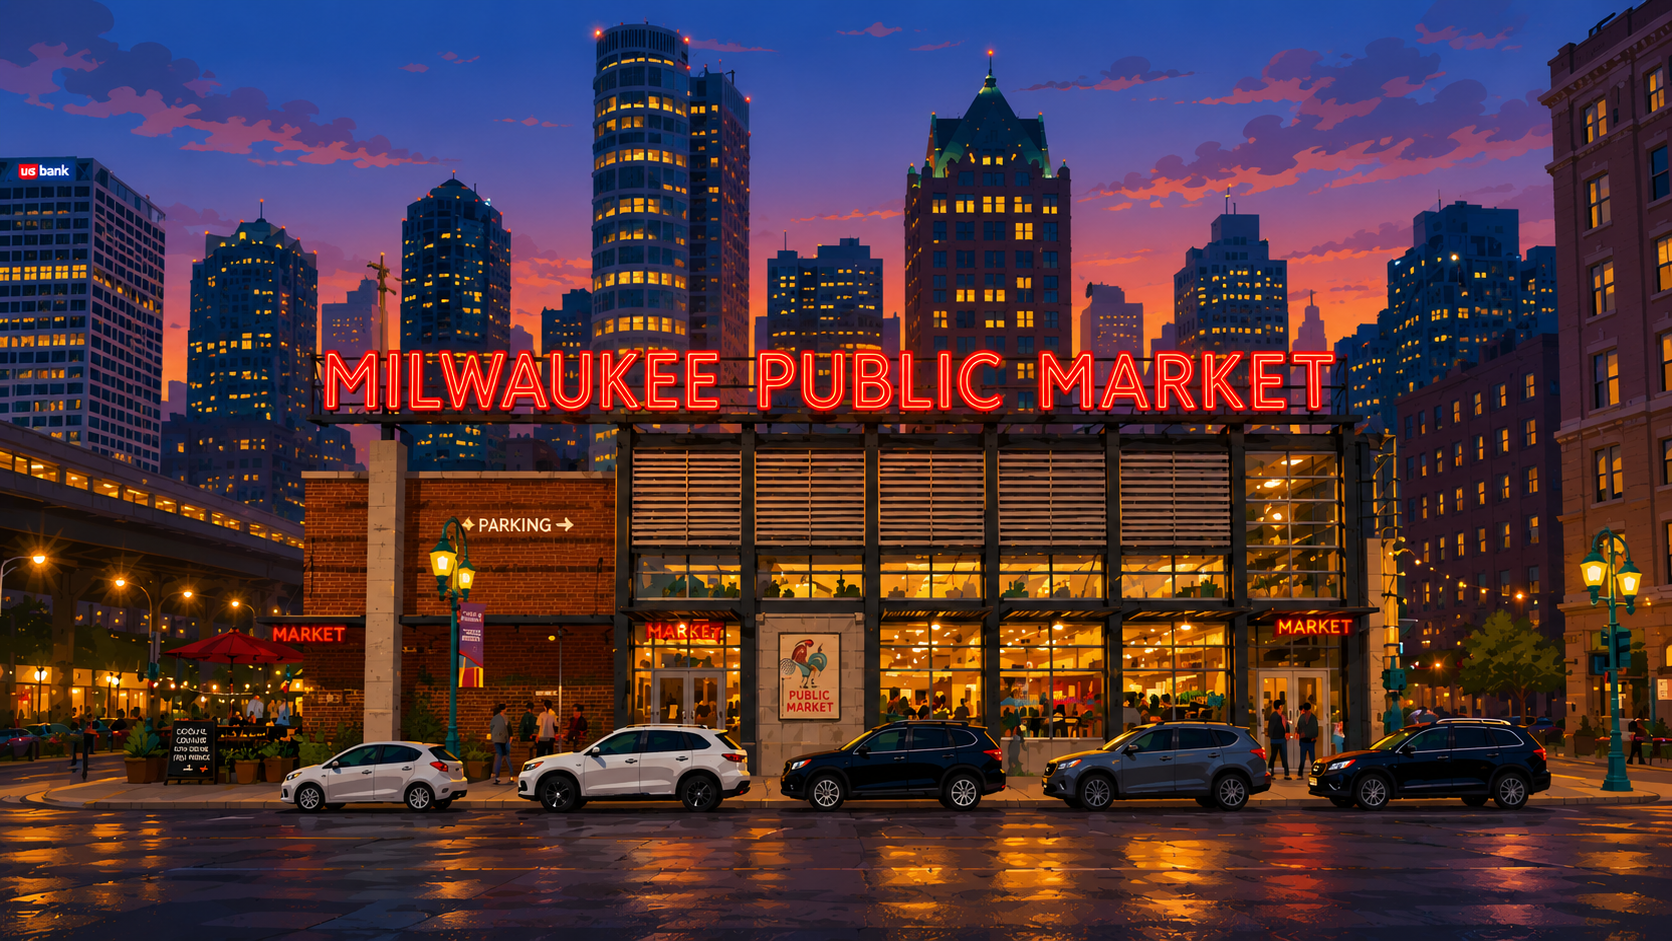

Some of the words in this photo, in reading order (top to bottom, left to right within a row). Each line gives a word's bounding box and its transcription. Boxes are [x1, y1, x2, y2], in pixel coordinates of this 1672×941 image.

[39, 164, 70, 176] bank
[323, 348, 721, 412] MILWAUKEE
[755, 348, 1005, 413] PUBLIC
[1037, 348, 1336, 413] MARKET
[478, 517, 552, 532] PARKING
[272, 626, 346, 642] MARKET
[647, 624, 722, 641] MARKET
[1277, 618, 1354, 635] MARKET
[788, 689, 830, 701] PUBLIC
[786, 701, 834, 713] MARKET
